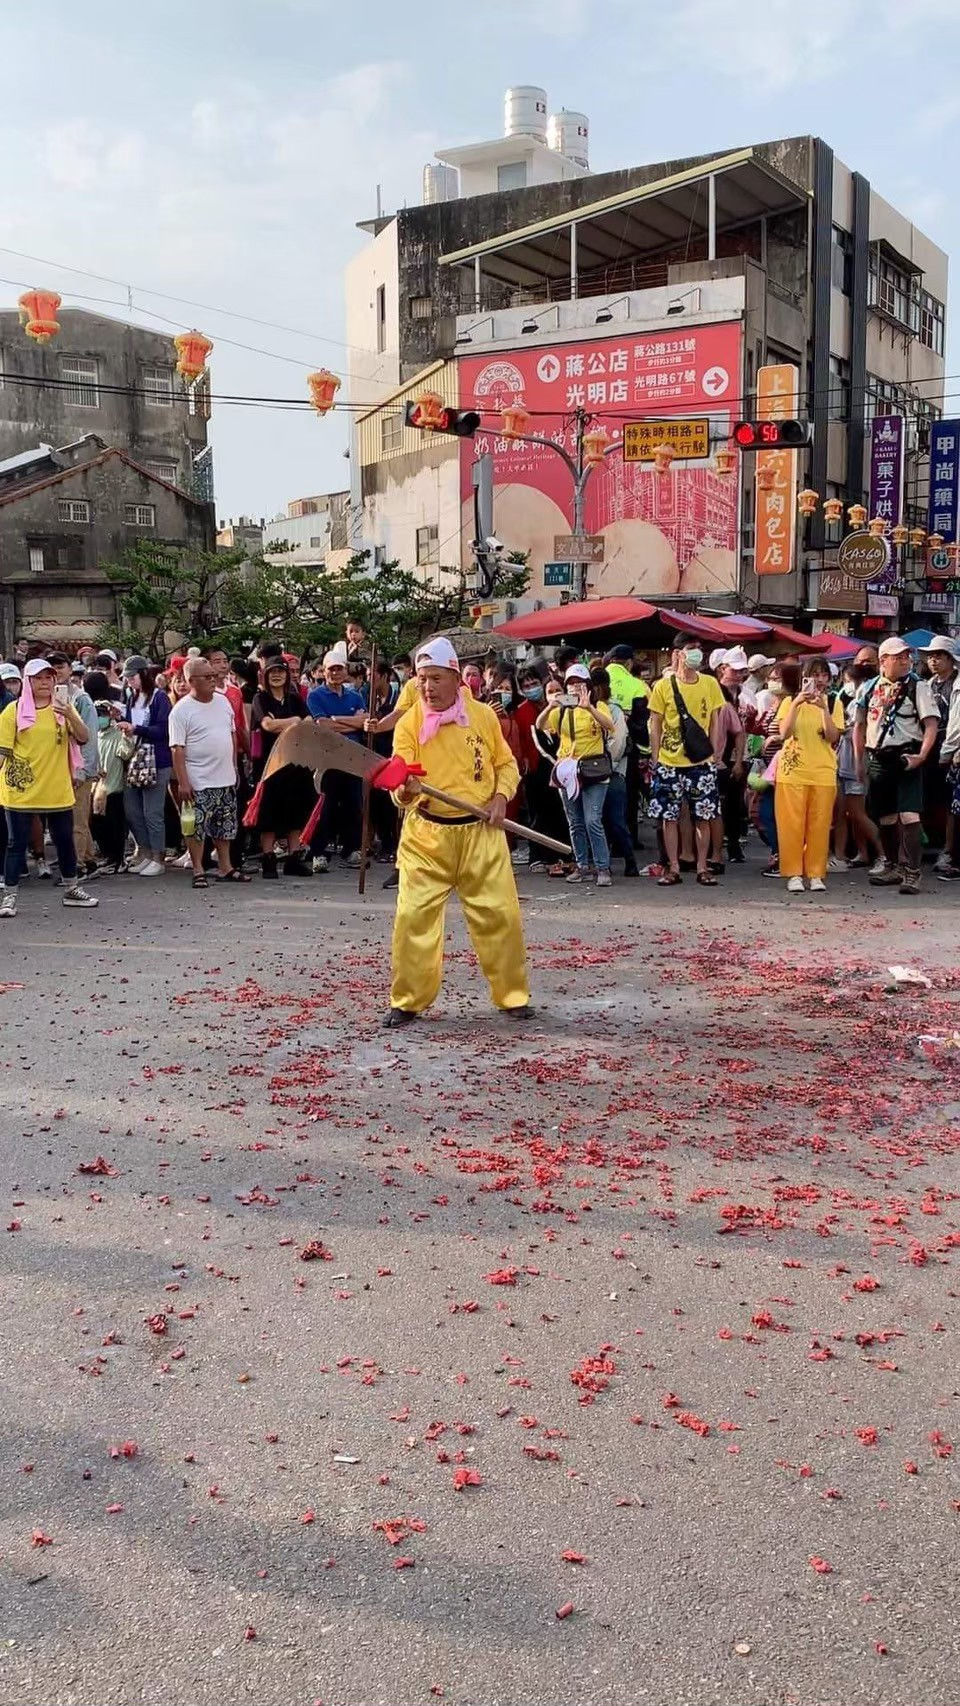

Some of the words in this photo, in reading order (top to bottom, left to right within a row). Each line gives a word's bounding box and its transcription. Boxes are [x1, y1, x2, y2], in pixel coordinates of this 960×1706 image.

[634, 338, 696, 358] 蔣公路131號
[565, 348, 629, 378] 蔣公店
[634, 370, 696, 389] 光明路67號
[565, 380, 629, 407] 光明店
[626, 425, 704, 440] 特殊時相路口
[762, 425, 778, 441] 50
[626, 441, 705, 457] 請依行駛
[933, 436, 955, 532] 甲尚藥局
